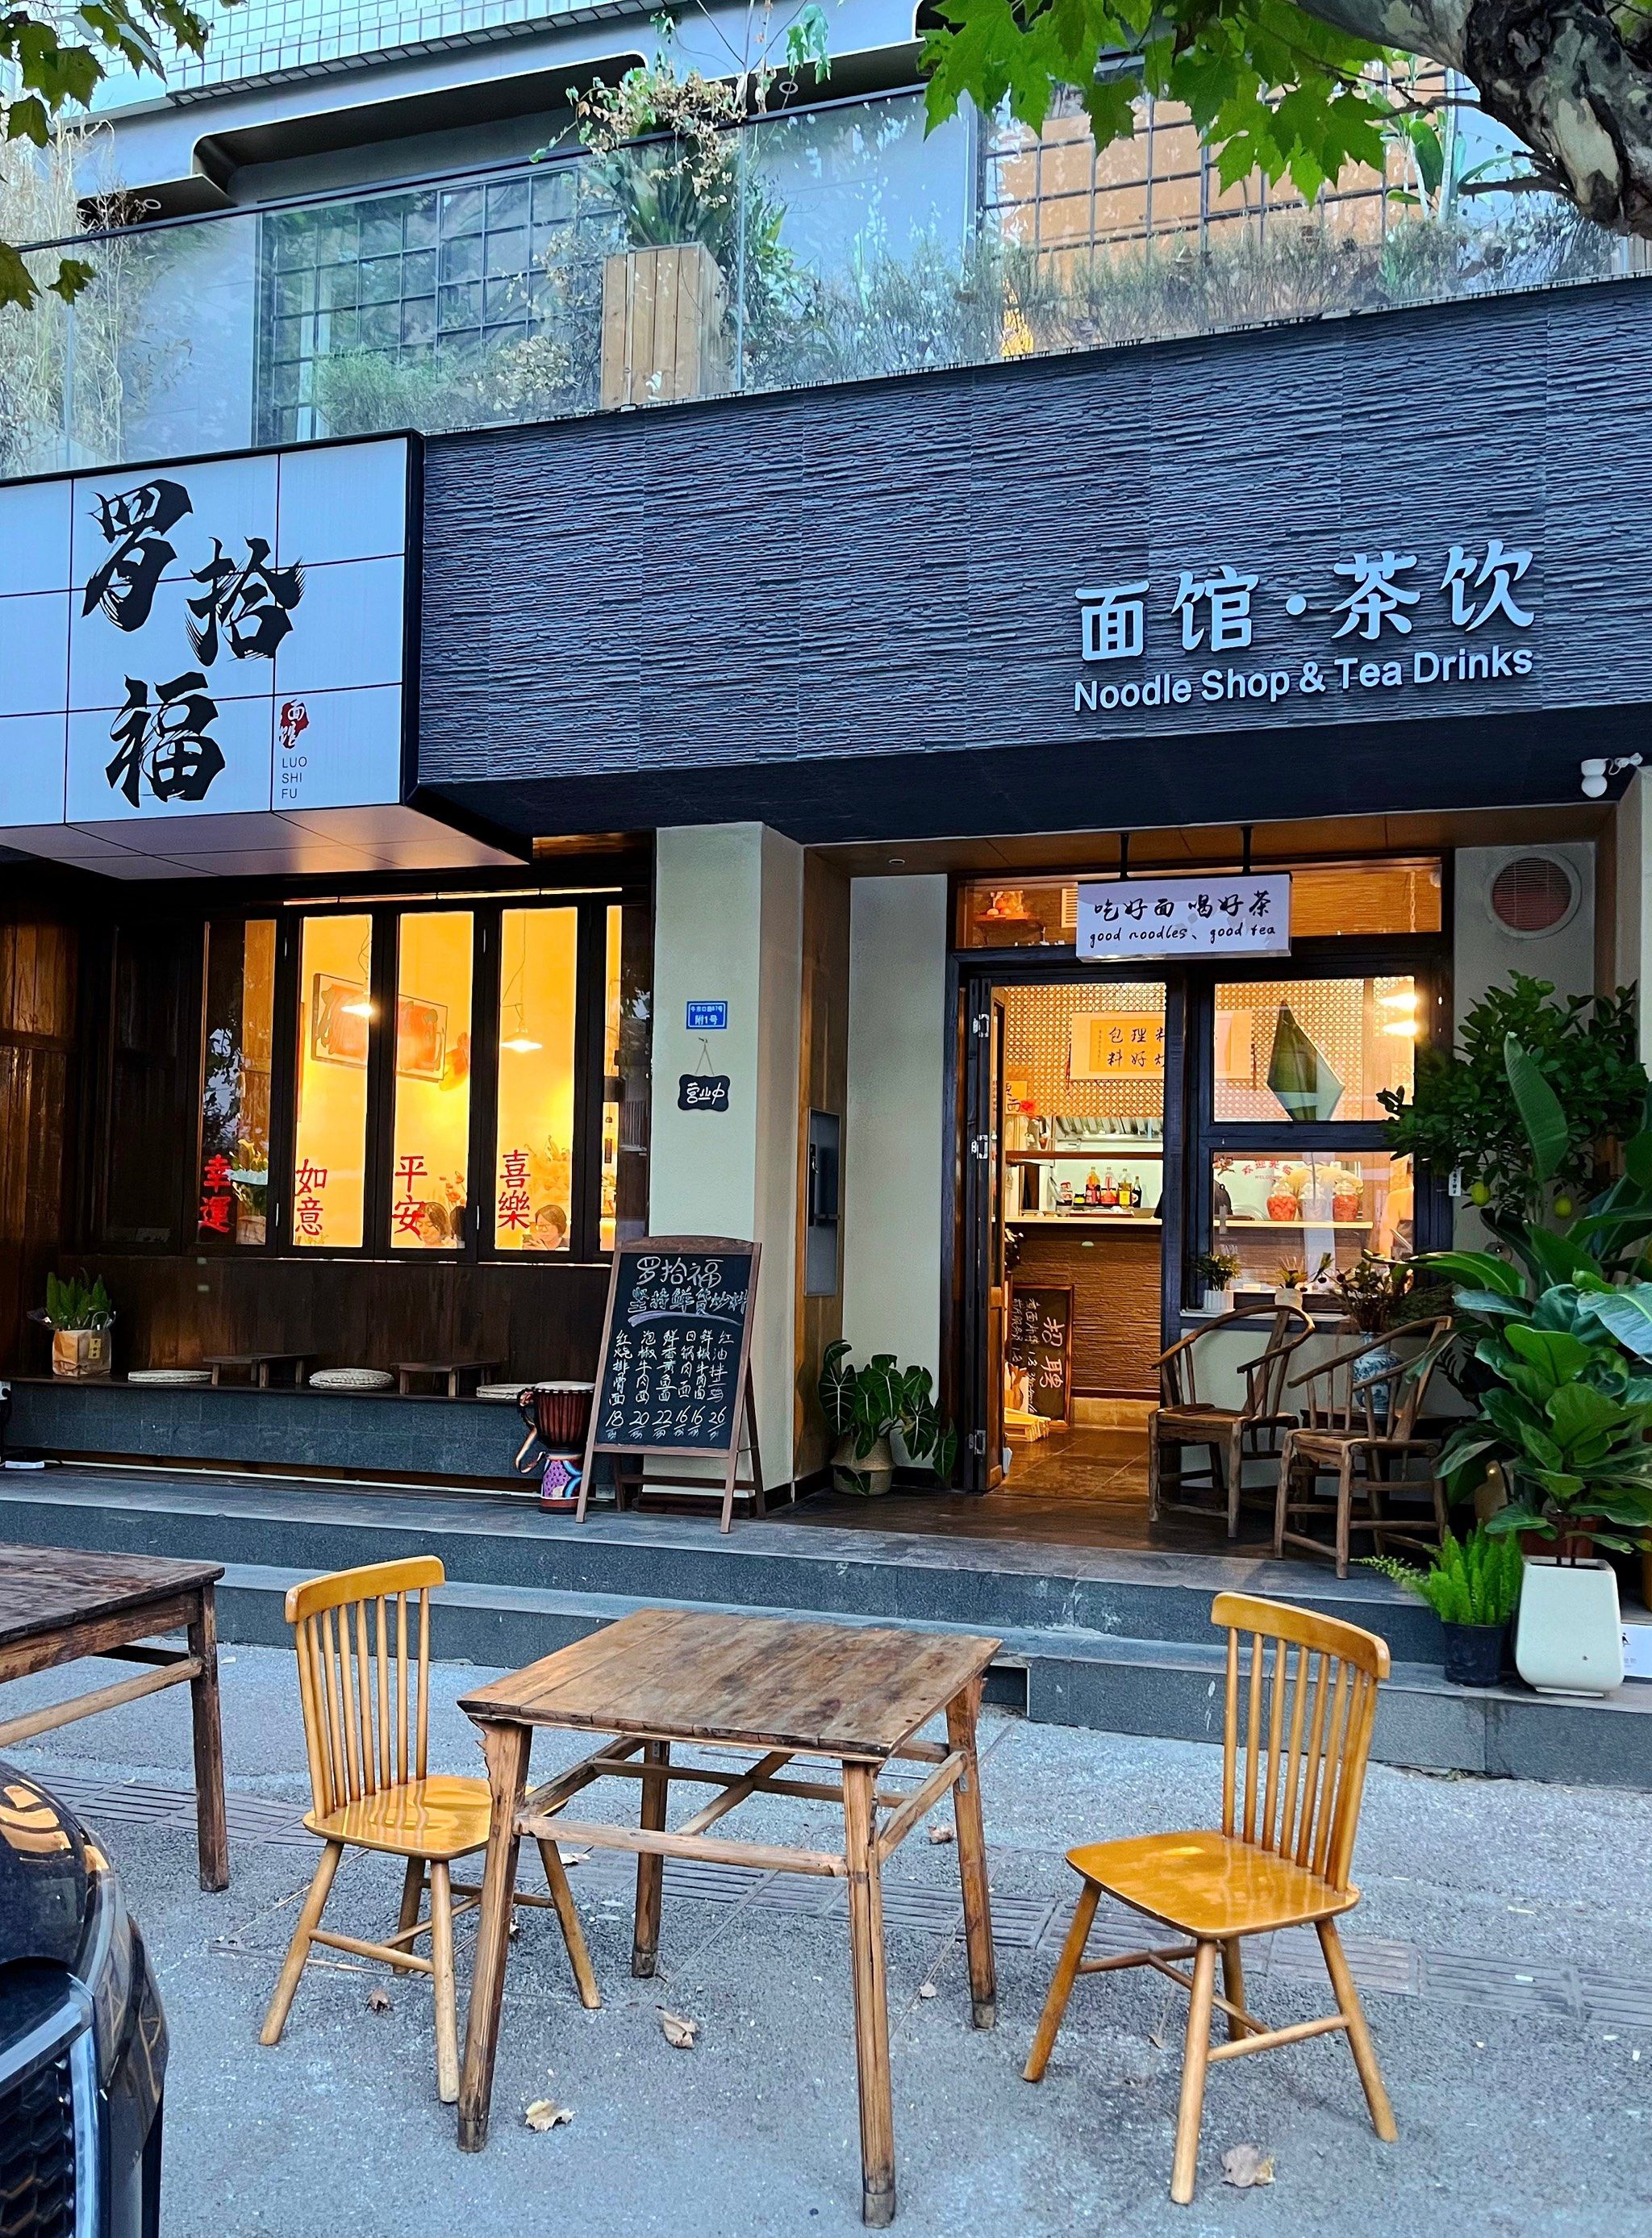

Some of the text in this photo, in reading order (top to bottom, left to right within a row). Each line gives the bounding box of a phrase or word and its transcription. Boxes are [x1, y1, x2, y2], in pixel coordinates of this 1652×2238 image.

[1074, 645, 1533, 712] Noodle Shop & Tea Drinks
[282, 757, 307, 768] LUO
[282, 772, 302, 784] SHI
[282, 788, 298, 800] FU
[1095, 890, 1272, 922] 吃好面 喝好茶
[1090, 927, 1121, 949] good
[1210, 922, 1244, 944] good
[1250, 924, 1276, 937] tea
[686, 1081, 726, 1105] 营业中
[294, 1159, 327, 1236] 如意
[391, 1155, 428, 1236] 平安
[497, 1149, 531, 1230] 喜樂
[636, 1256, 724, 1288] 罗拾福
[608, 1329, 632, 1406] 红烧排骨面
[635, 1330, 657, 1405] 泡椒牛肉面
[1039, 1317, 1066, 1388] 招聘
